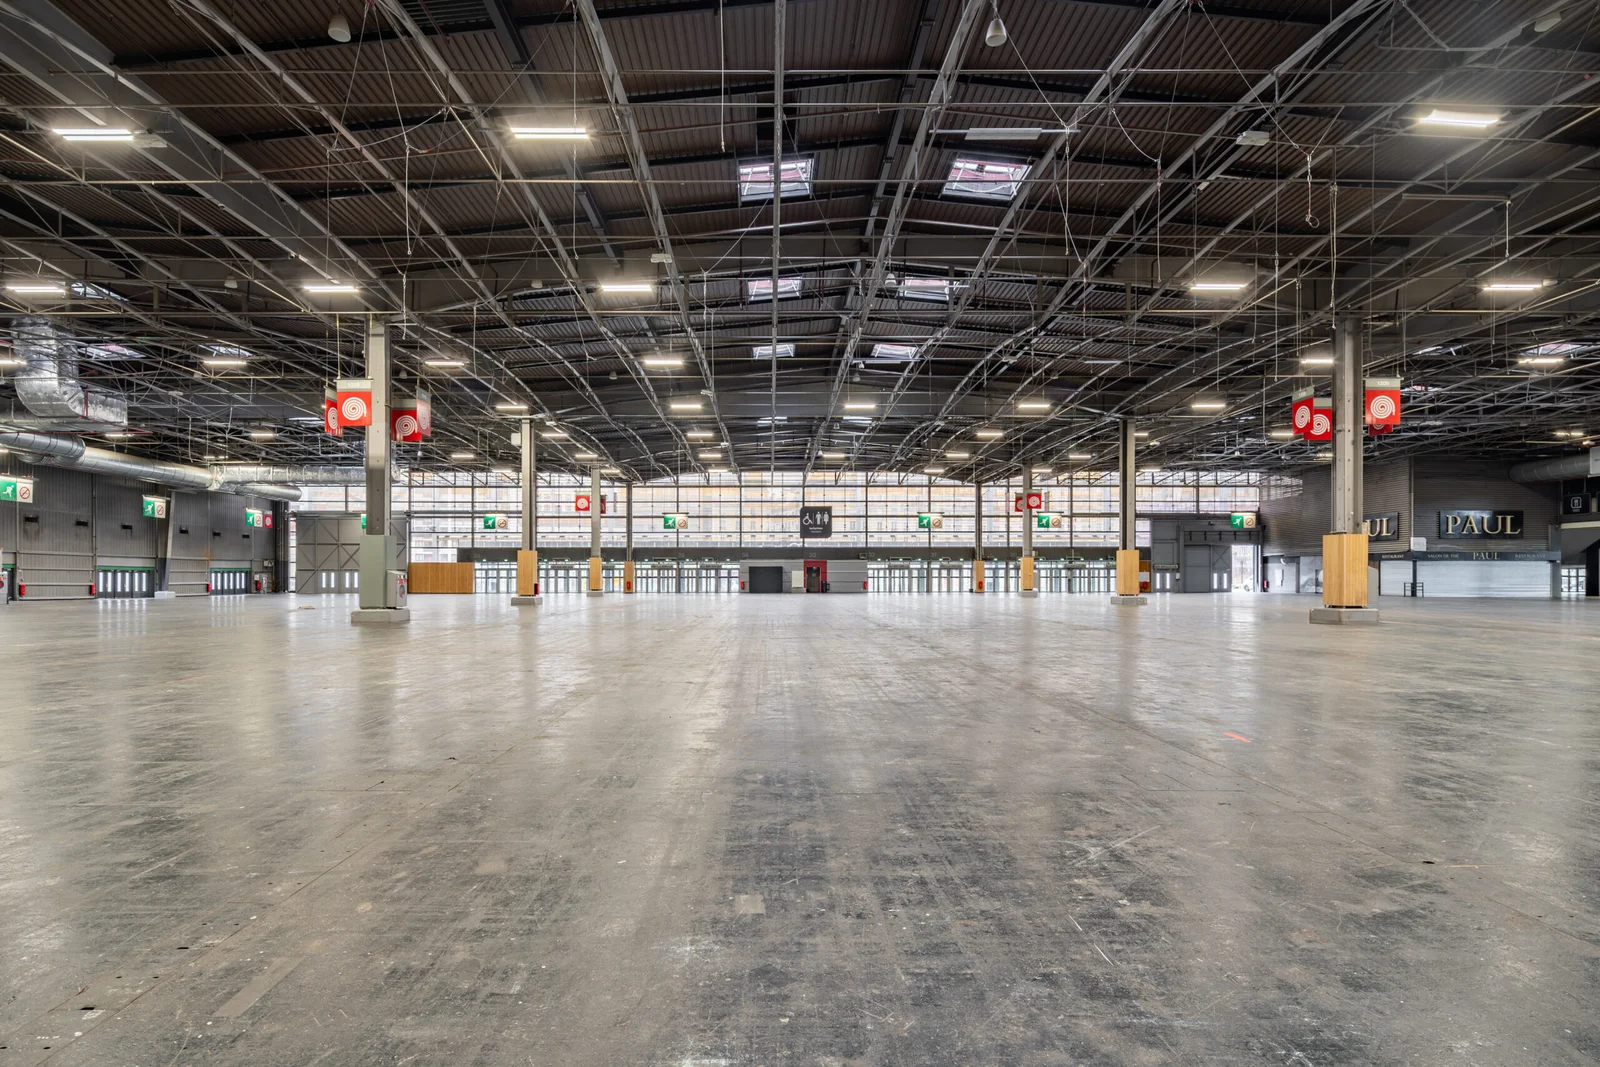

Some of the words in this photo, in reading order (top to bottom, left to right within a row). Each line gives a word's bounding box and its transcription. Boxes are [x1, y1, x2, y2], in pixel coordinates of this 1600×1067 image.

[1365, 517, 1395, 537] UL
[1446, 515, 1521, 534] PAUL
[1472, 551, 1500, 560] PAUL
